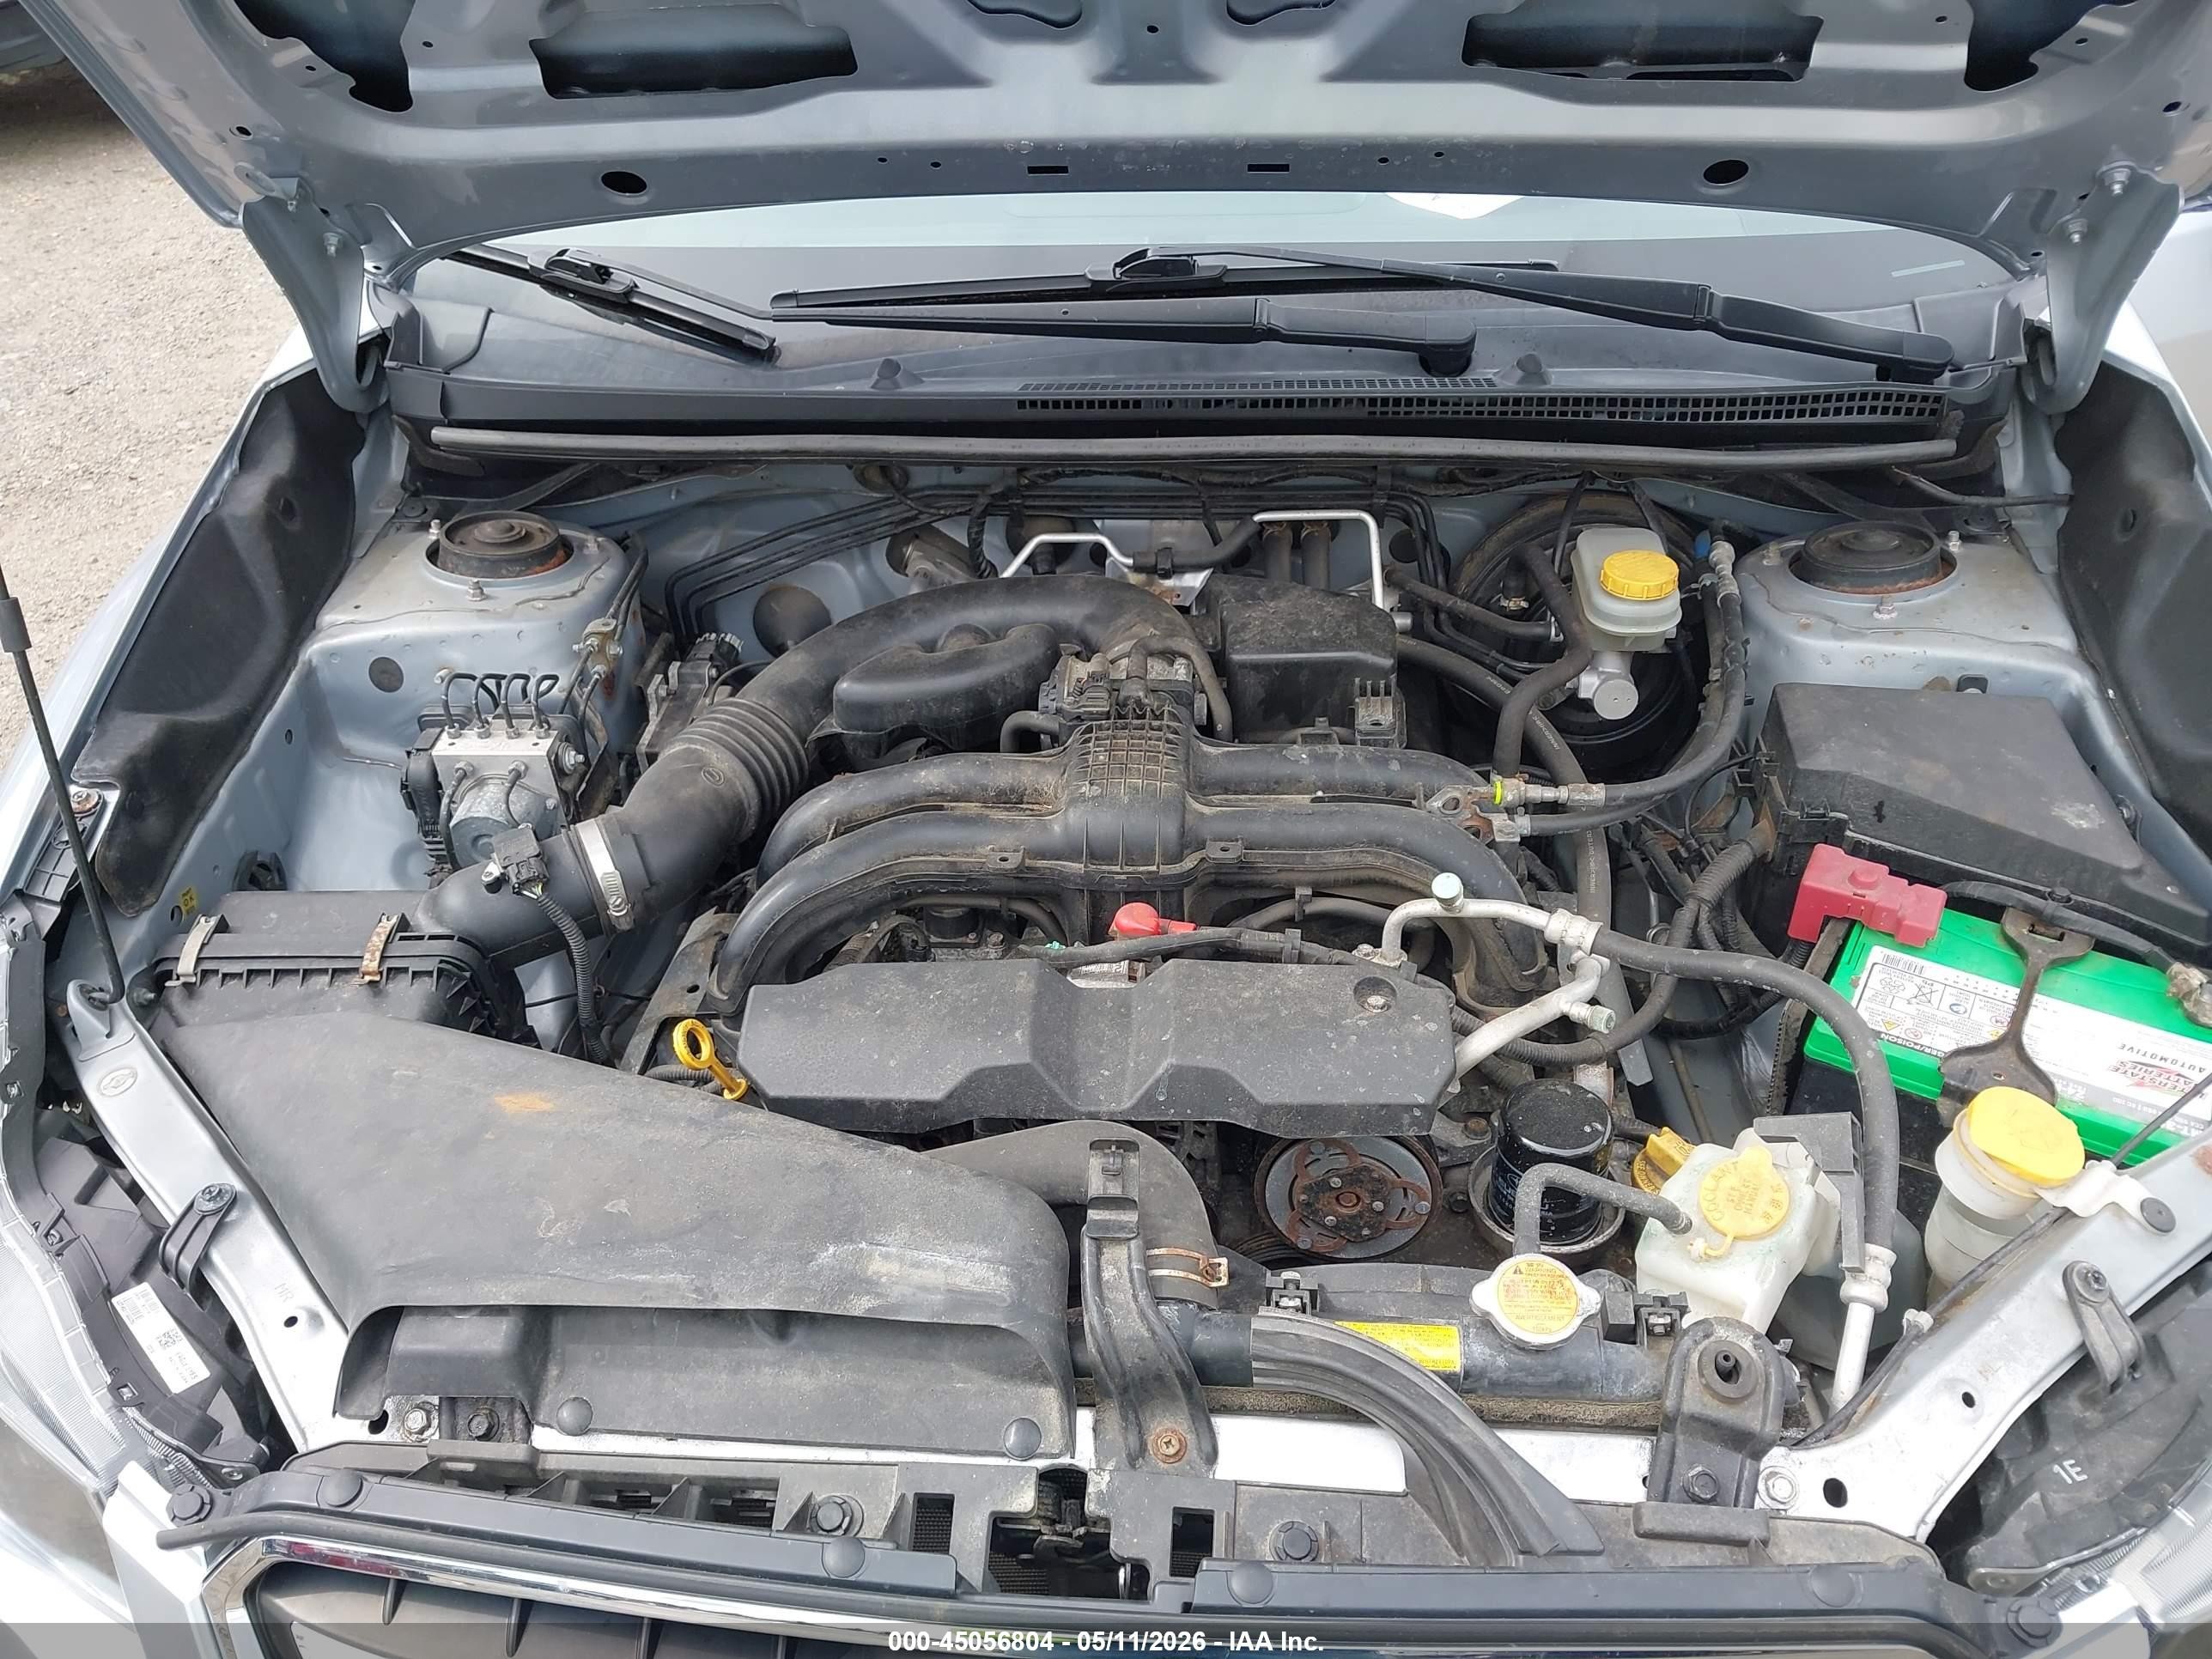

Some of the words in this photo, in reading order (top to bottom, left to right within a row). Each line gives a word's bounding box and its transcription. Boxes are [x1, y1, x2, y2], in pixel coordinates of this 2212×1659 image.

[1879, 1033, 1946, 1058] GER/POISON
[2117, 1043, 2207, 1073] AUTOMOTIVE
[2108, 1065, 2207, 1099] ITERSTATE
[2117, 1060, 2196, 1086] ATTERIES
[2052, 1459, 2088, 1485] 1E
